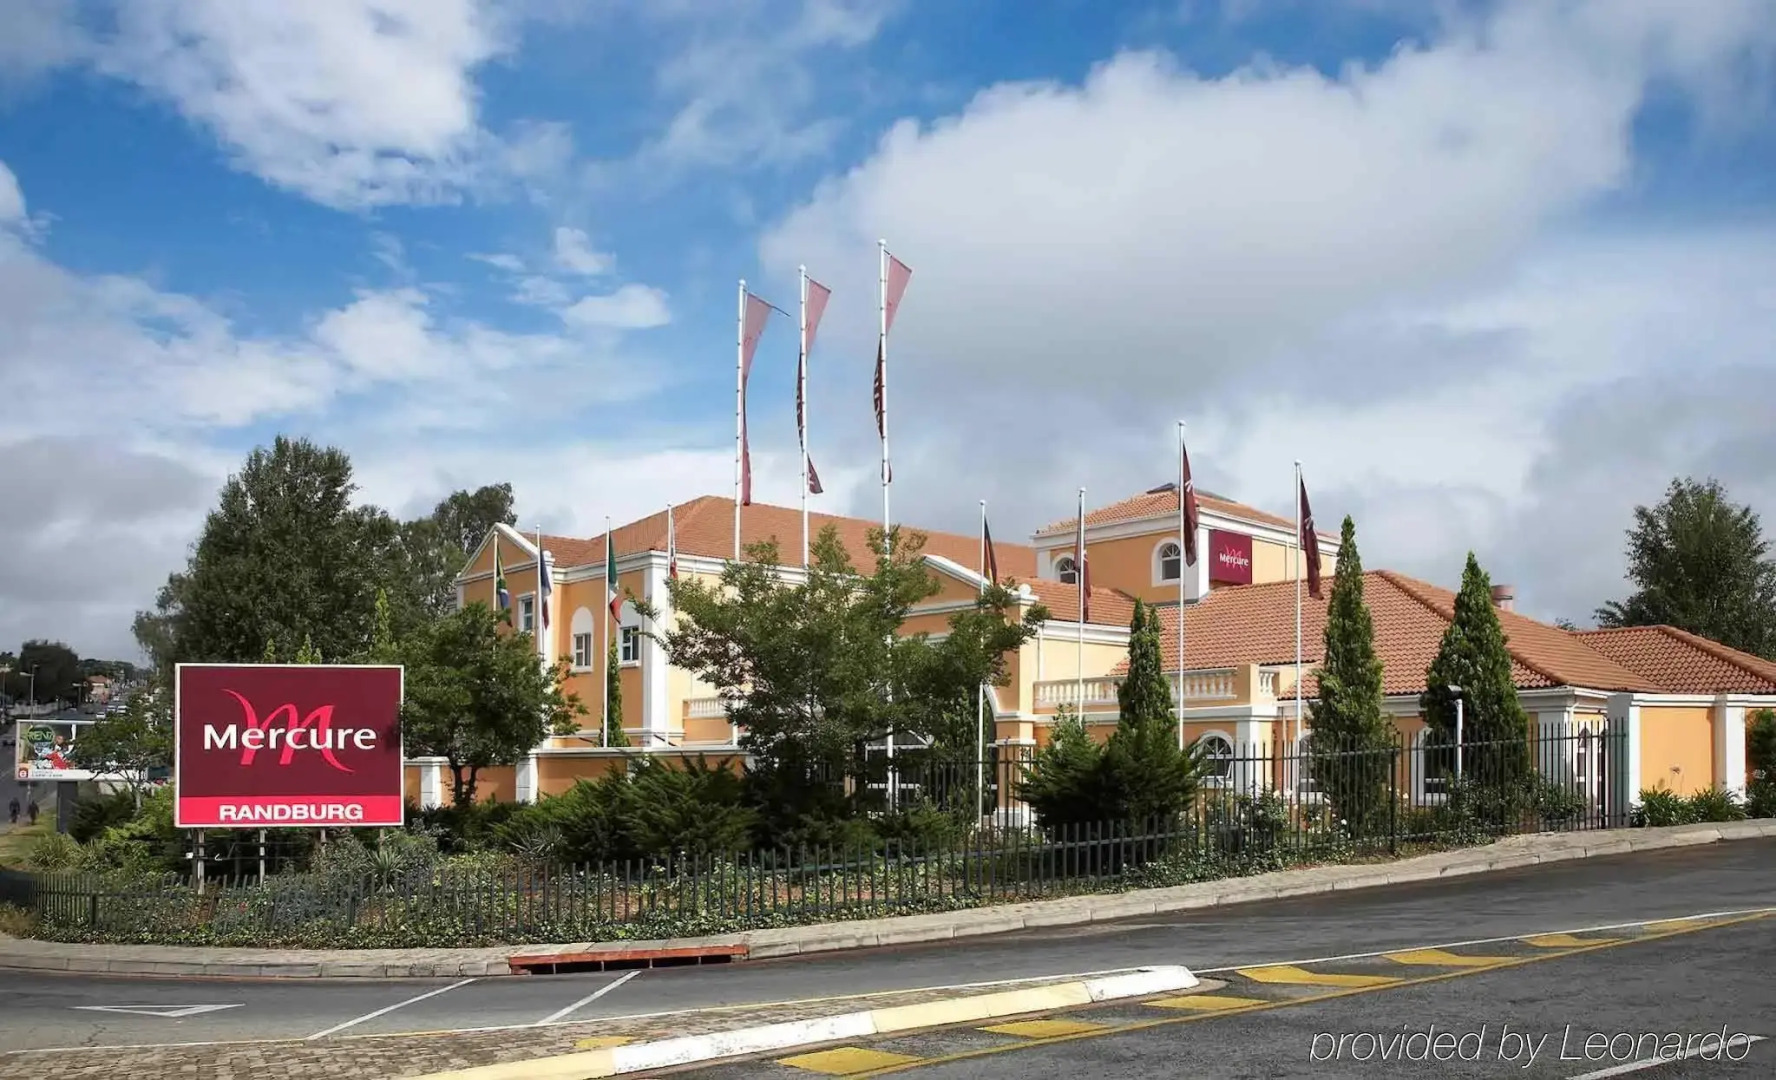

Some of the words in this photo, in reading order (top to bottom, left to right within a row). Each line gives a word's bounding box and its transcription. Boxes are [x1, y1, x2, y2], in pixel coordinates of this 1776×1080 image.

[1219, 553, 1249, 566] Mercure
[203, 724, 377, 750] Mercure
[219, 804, 364, 821] RANDBURG
